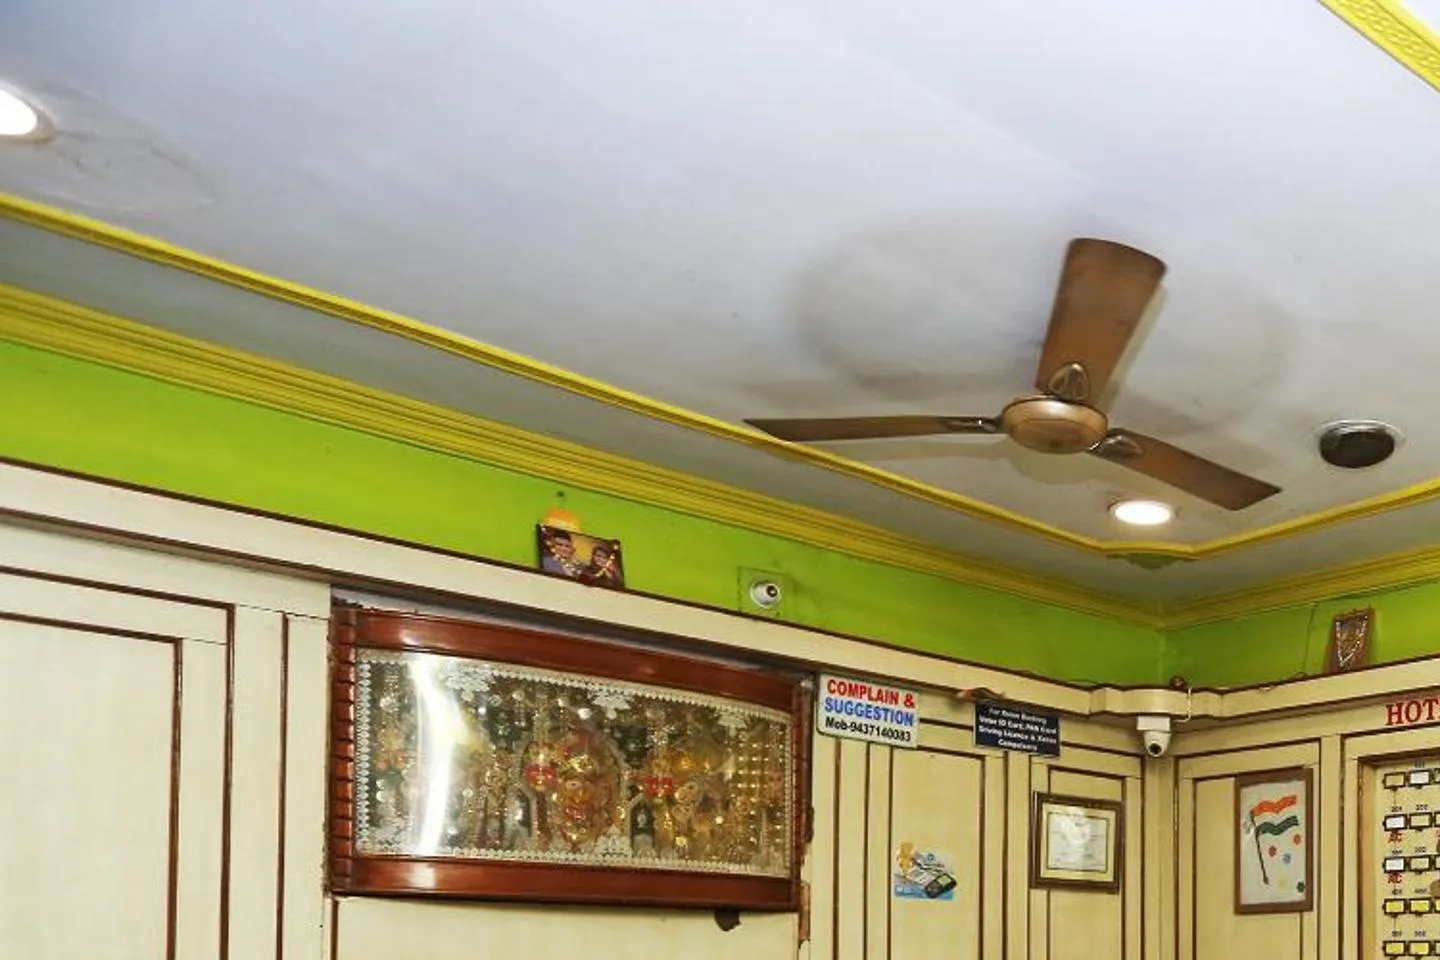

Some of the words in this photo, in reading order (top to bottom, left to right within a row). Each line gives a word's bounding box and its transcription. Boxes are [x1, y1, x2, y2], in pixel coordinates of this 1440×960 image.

[827, 679, 899, 706] COMPLAIN
[904, 692, 915, 708] &
[824, 696, 914, 727] SUGGESTION
